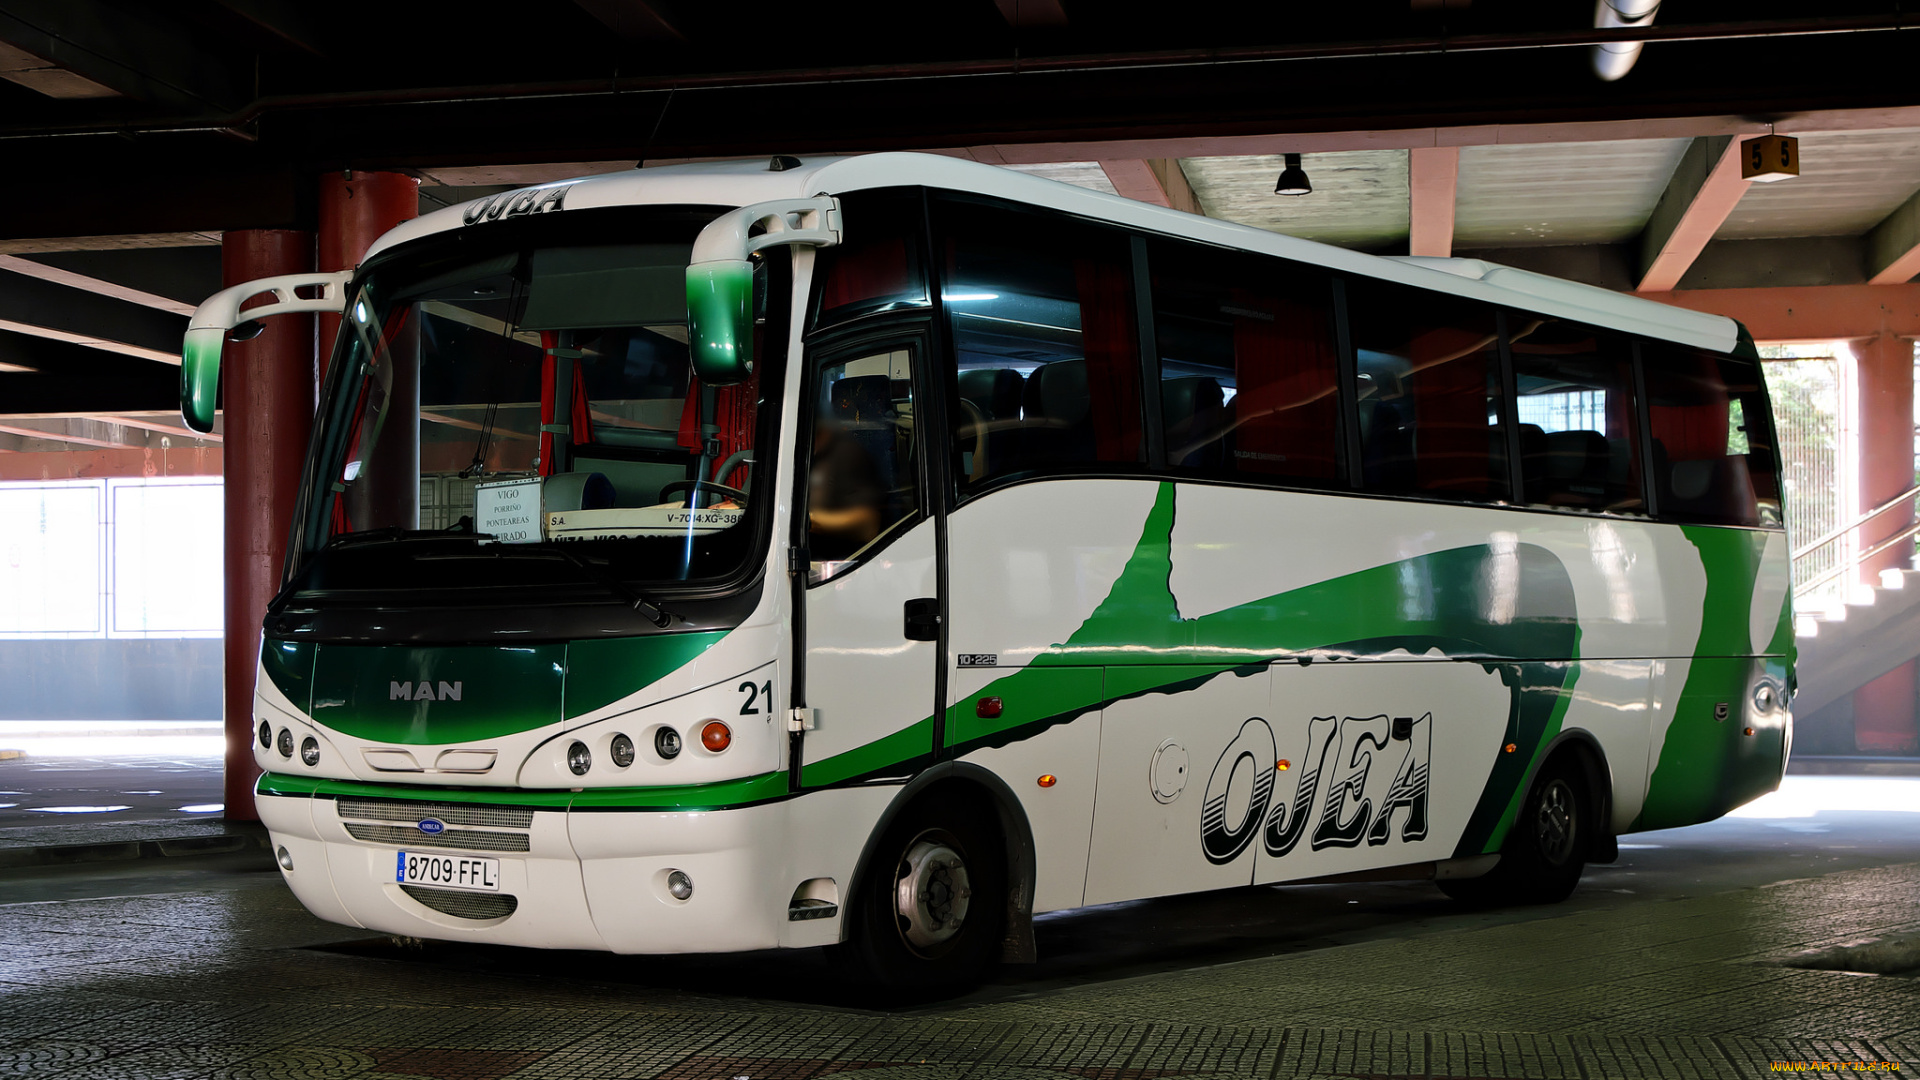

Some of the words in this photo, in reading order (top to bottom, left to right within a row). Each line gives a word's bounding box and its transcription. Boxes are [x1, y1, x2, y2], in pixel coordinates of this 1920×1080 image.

[1752, 143, 1762, 170] 5
[1781, 140, 1790, 168] 5
[462, 184, 573, 226] OJEA
[497, 489, 519, 499] VIGO
[486, 516, 530, 528] PONTEAREAS
[494, 504, 522, 513] PORRIÑO
[551, 517, 566, 526] S.A.
[390, 681, 462, 701] MAN
[738, 679, 772, 715] 21
[1200, 711, 1432, 866] OJEA
[408, 857, 453, 882] 8709
[459, 860, 494, 887] FFL
